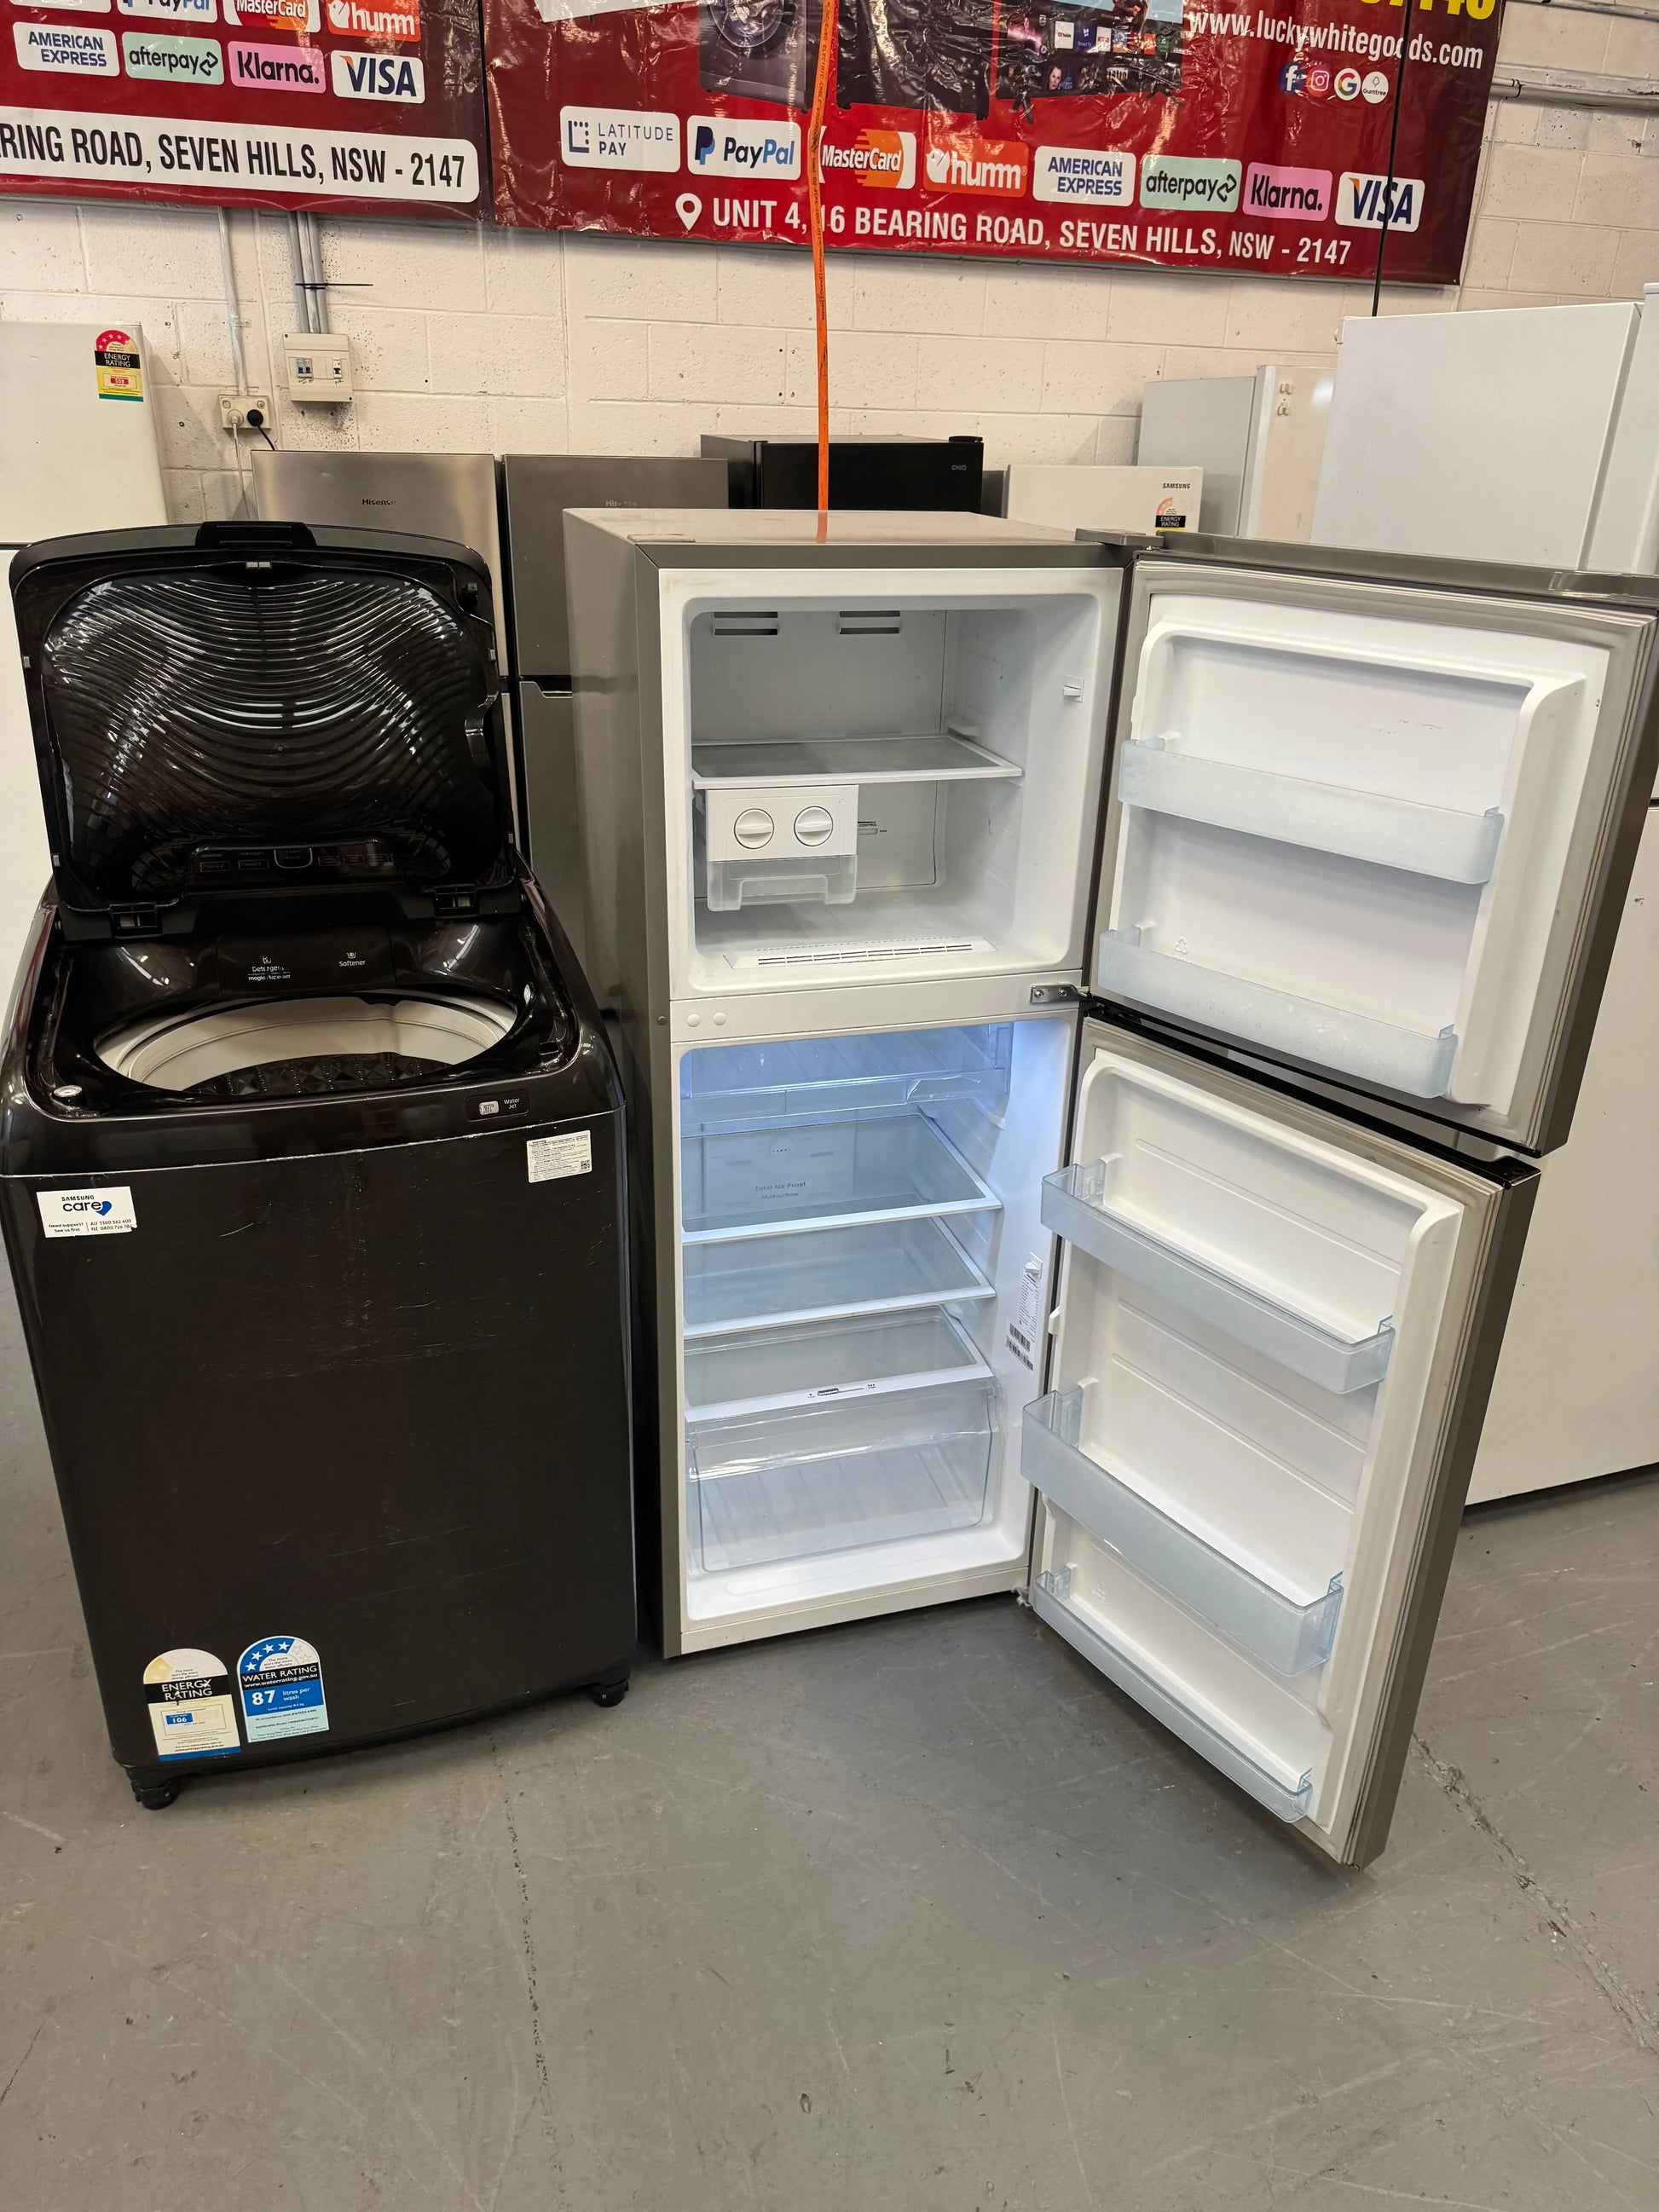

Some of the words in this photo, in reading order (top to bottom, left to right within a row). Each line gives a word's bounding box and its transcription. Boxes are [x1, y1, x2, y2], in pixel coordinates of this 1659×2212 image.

[350, 2, 415, 36] humm
[28, 31, 104, 51] AMERICAN
[1189, 9, 1483, 69] www.luckywhitegoods.com
[40, 49, 107, 67] EXPRESS
[129, 46, 199, 75] afterpay
[237, 50, 320, 84] Klarna.
[339, 55, 417, 97] VISA
[598, 122, 673, 141] LATITUDE
[0, 123, 65, 163] RING
[71, 128, 152, 174] ROAD,
[158, 133, 243, 174] SEVEN
[246, 140, 325, 186] HILLS,
[331, 147, 386, 183] NSW
[410, 152, 465, 188] 2147
[598, 141, 627, 156] PAY
[723, 136, 795, 169] PayPal
[822, 144, 902, 172] MasterCard
[951, 150, 1021, 190] humm
[1047, 156, 1123, 177] AMERICAN
[1057, 176, 1123, 196] EXPRESS
[1146, 170, 1218, 201] afterpay
[1250, 173, 1323, 211] Klarna.
[1349, 177, 1413, 225] VISA
[713, 197, 777, 228] UNIT
[784, 201, 807, 235] 4,
[855, 206, 967, 242] BEARING
[976, 215, 1050, 250] ROAD,
[1059, 220, 1138, 251] SEVEN
[1146, 226, 1223, 259] HILLS,
[1228, 230, 1275, 260] NSW
[1297, 237, 1352, 265] 2147
[103, 352, 131, 361] ENERGY
[105, 359, 131, 367] RATING
[338, 959, 367, 967] Softener
[503, 1097, 521, 1106] Water
[62, 1201, 102, 1212] care
[242, 1672, 277, 1683] WATER
[280, 1665, 317, 1678] RATING
[244, 1673, 318, 1688] www.waterrating.gov.au
[165, 1688, 212, 1701] RATING
[251, 1689, 275, 1706] 87
